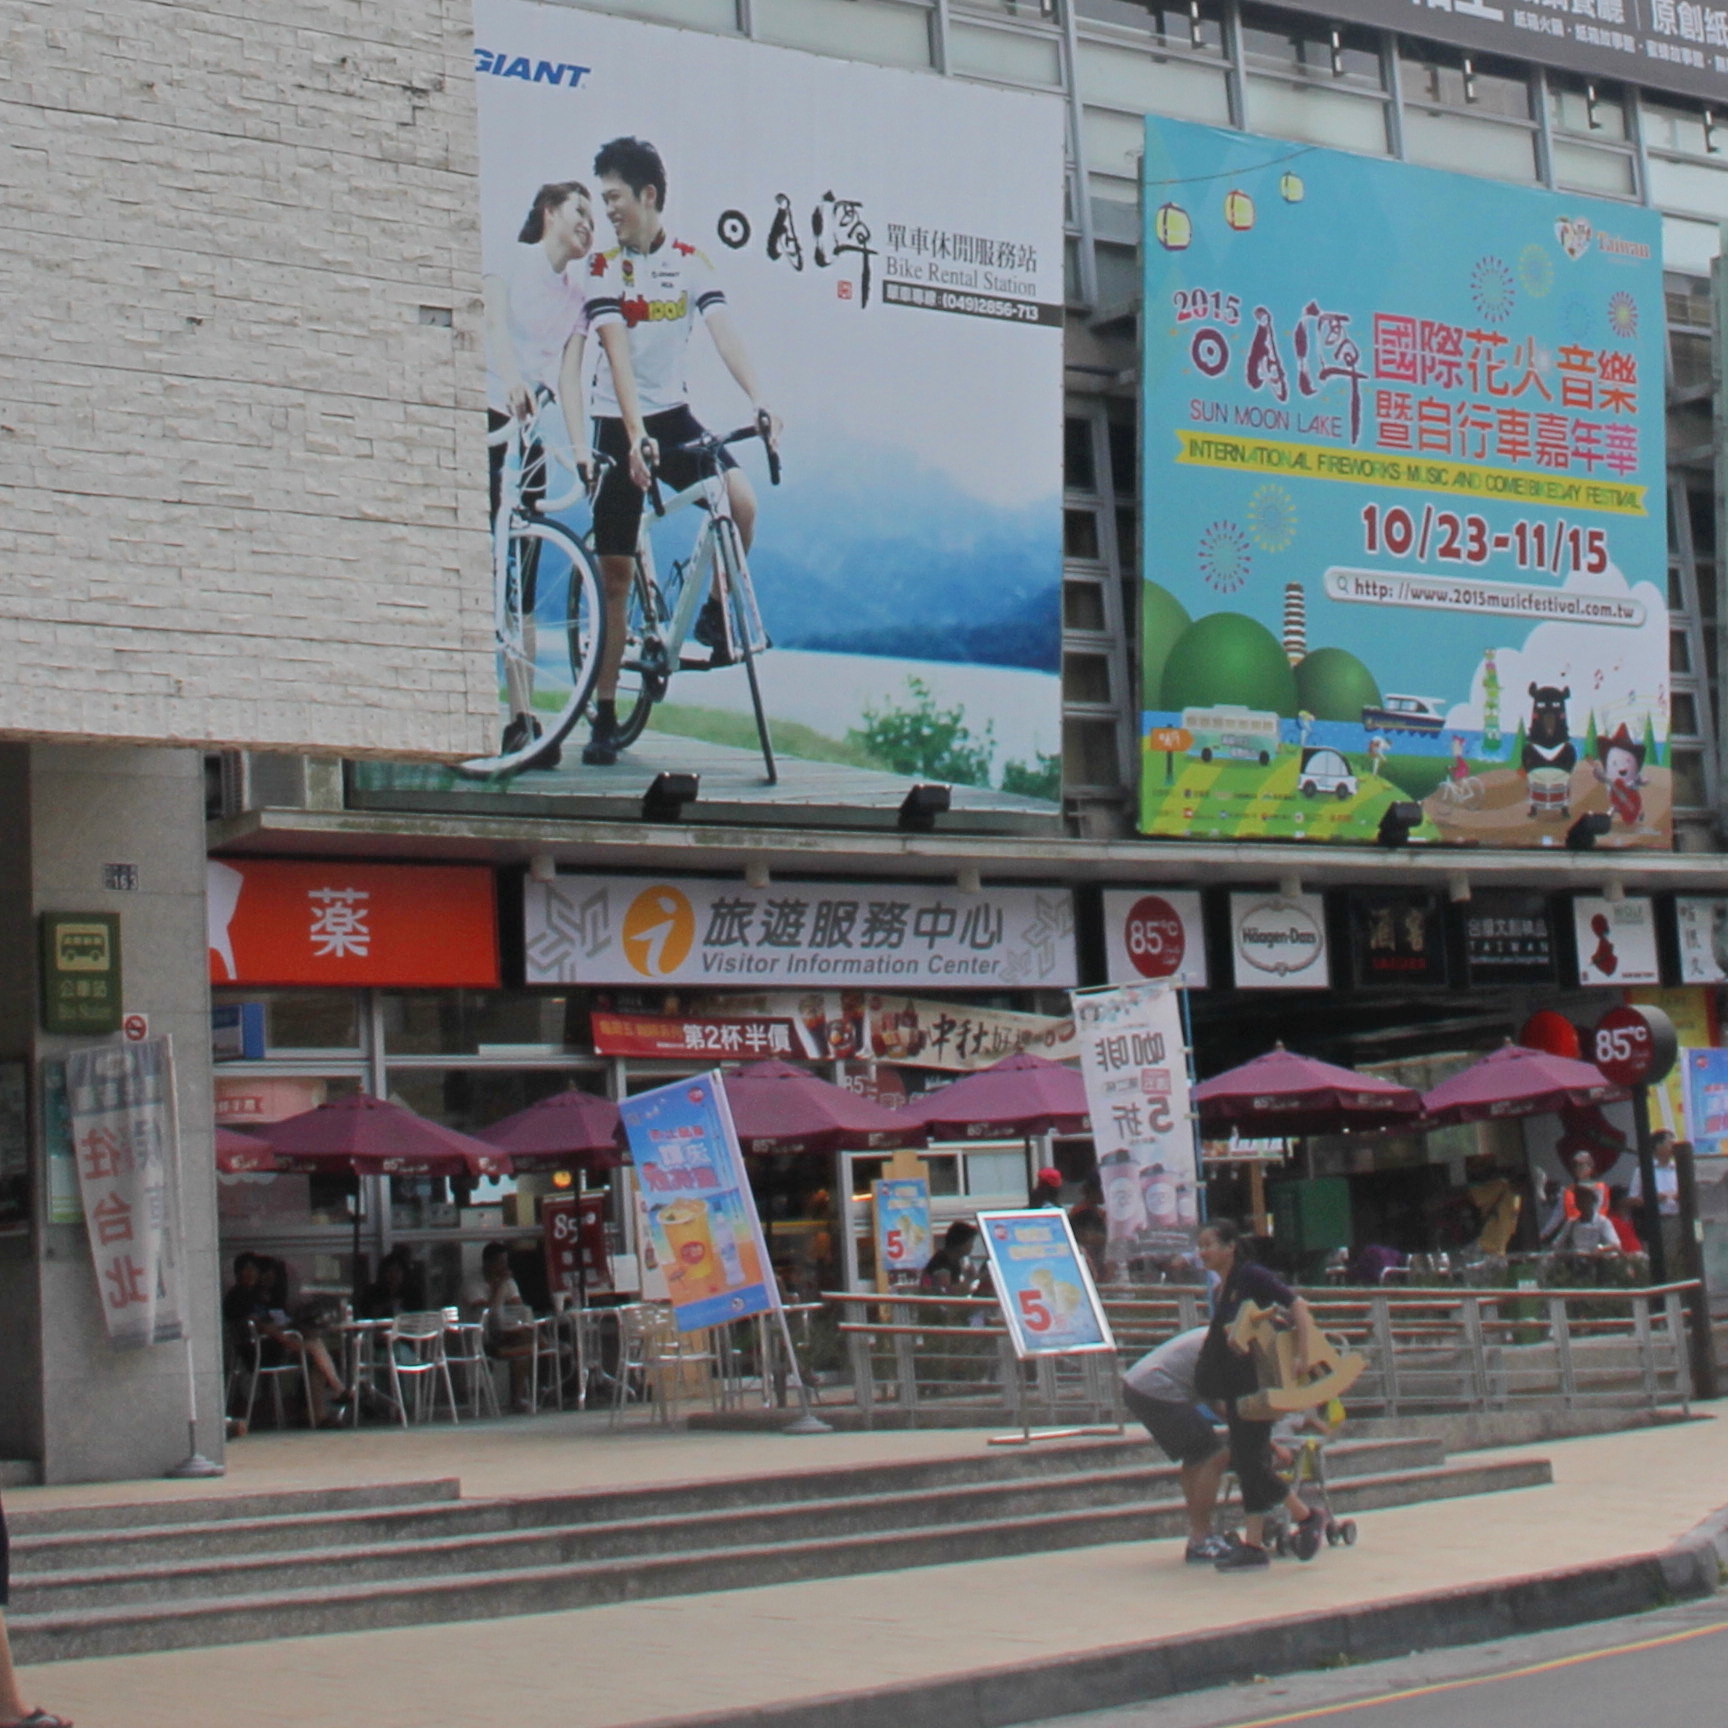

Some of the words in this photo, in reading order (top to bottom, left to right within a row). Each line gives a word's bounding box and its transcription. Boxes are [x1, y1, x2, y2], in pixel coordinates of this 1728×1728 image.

[473, 48, 590, 89] GIANT
[1596, 232, 1650, 259] Taiwan
[887, 256, 922, 280] Bike
[928, 262, 978, 289] Rental
[984, 272, 1036, 297] Station
[1174, 288, 1242, 326] 2015
[1373, 312, 1639, 416] 國際花火音樂
[1190, 399, 1228, 423] SUN
[1234, 404, 1290, 431] MOON
[1297, 412, 1343, 439] LAKE
[1375, 389, 1640, 477] 暨自行車嘉年華
[1189, 438, 1312, 471] INTERNATIONAL
[1318, 453, 1401, 480] FIREWORKS
[1407, 463, 1449, 487] MUSIC
[1452, 470, 1482, 491] AND
[1585, 485, 1643, 511] FESTIVAL
[1361, 502, 1609, 575] 10/23-11/15
[702, 898, 1004, 952] 旅遊服務中心
[1130, 920, 1179, 954] 85°C
[1242, 927, 1317, 950] Häagen-Dazs
[702, 951, 779, 974] Visitor
[787, 952, 920, 976] Information
[928, 954, 1001, 976] Center
[683, 1023, 792, 1055] 第2杯半價
[1595, 1025, 1648, 1063] 85°C
[886, 1229, 905, 1261] 5
[1016, 1288, 1053, 1333] 5
